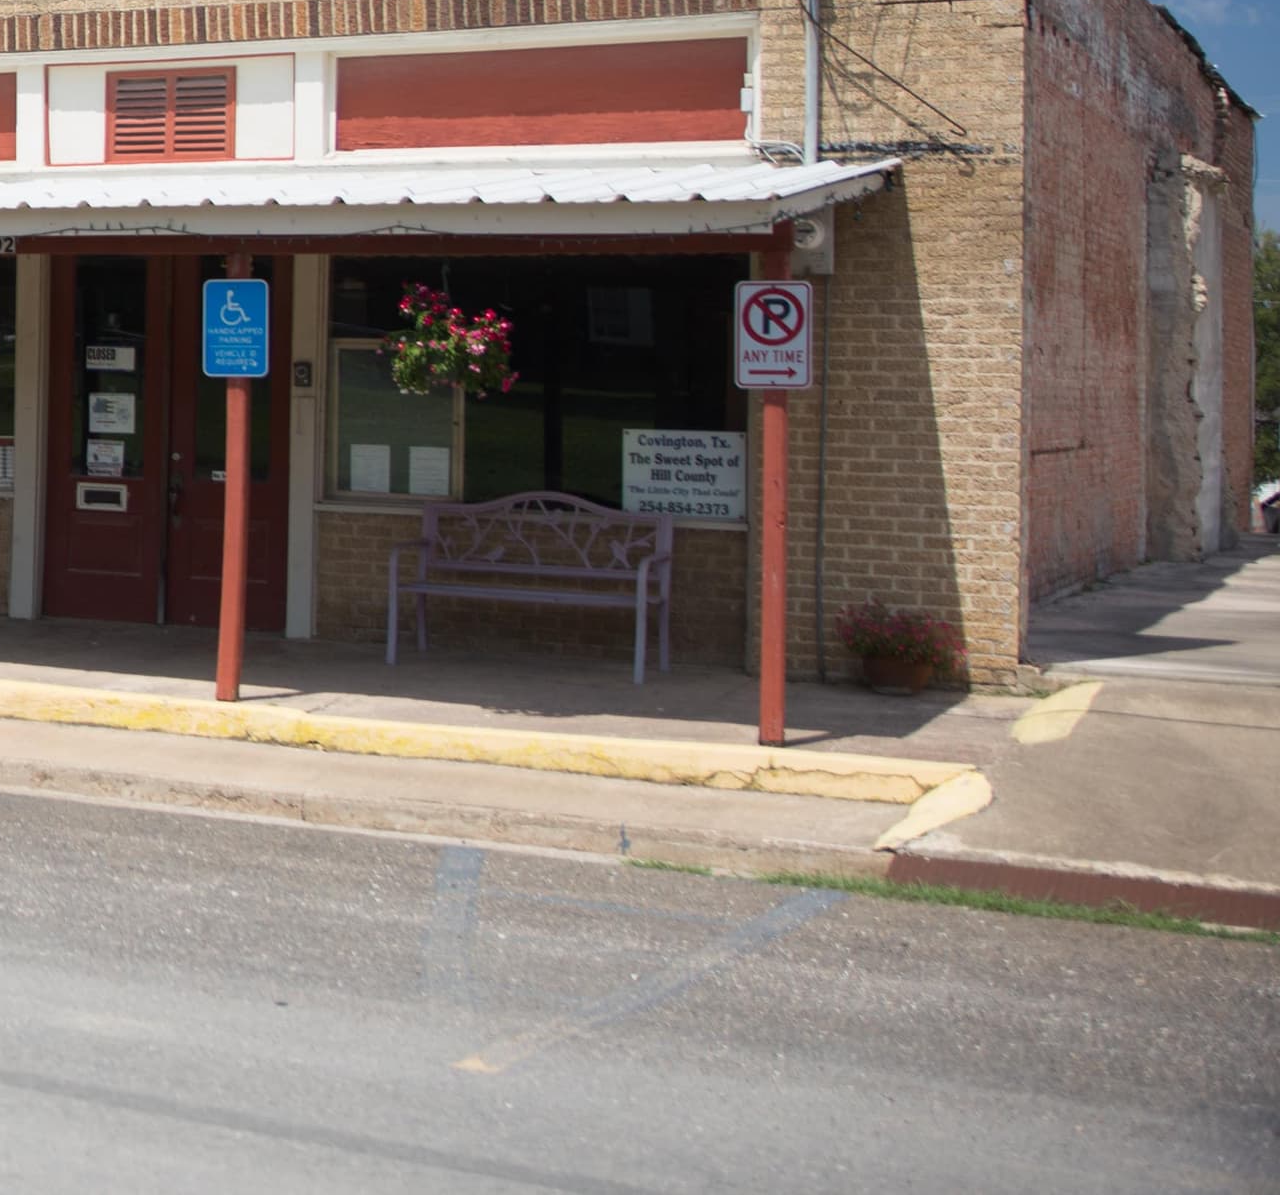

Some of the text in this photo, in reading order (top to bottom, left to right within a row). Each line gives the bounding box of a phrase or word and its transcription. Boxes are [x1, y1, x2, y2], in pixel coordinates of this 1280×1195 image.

[87, 347, 116, 361] CLOSED
[743, 349, 804, 364] ANY TIME
[638, 434, 731, 450] Covington, Tx.
[629, 452, 739, 469] The Sweet Spot of
[650, 469, 717, 486] Hill County
[639, 500, 730, 516] 254-854-2373
